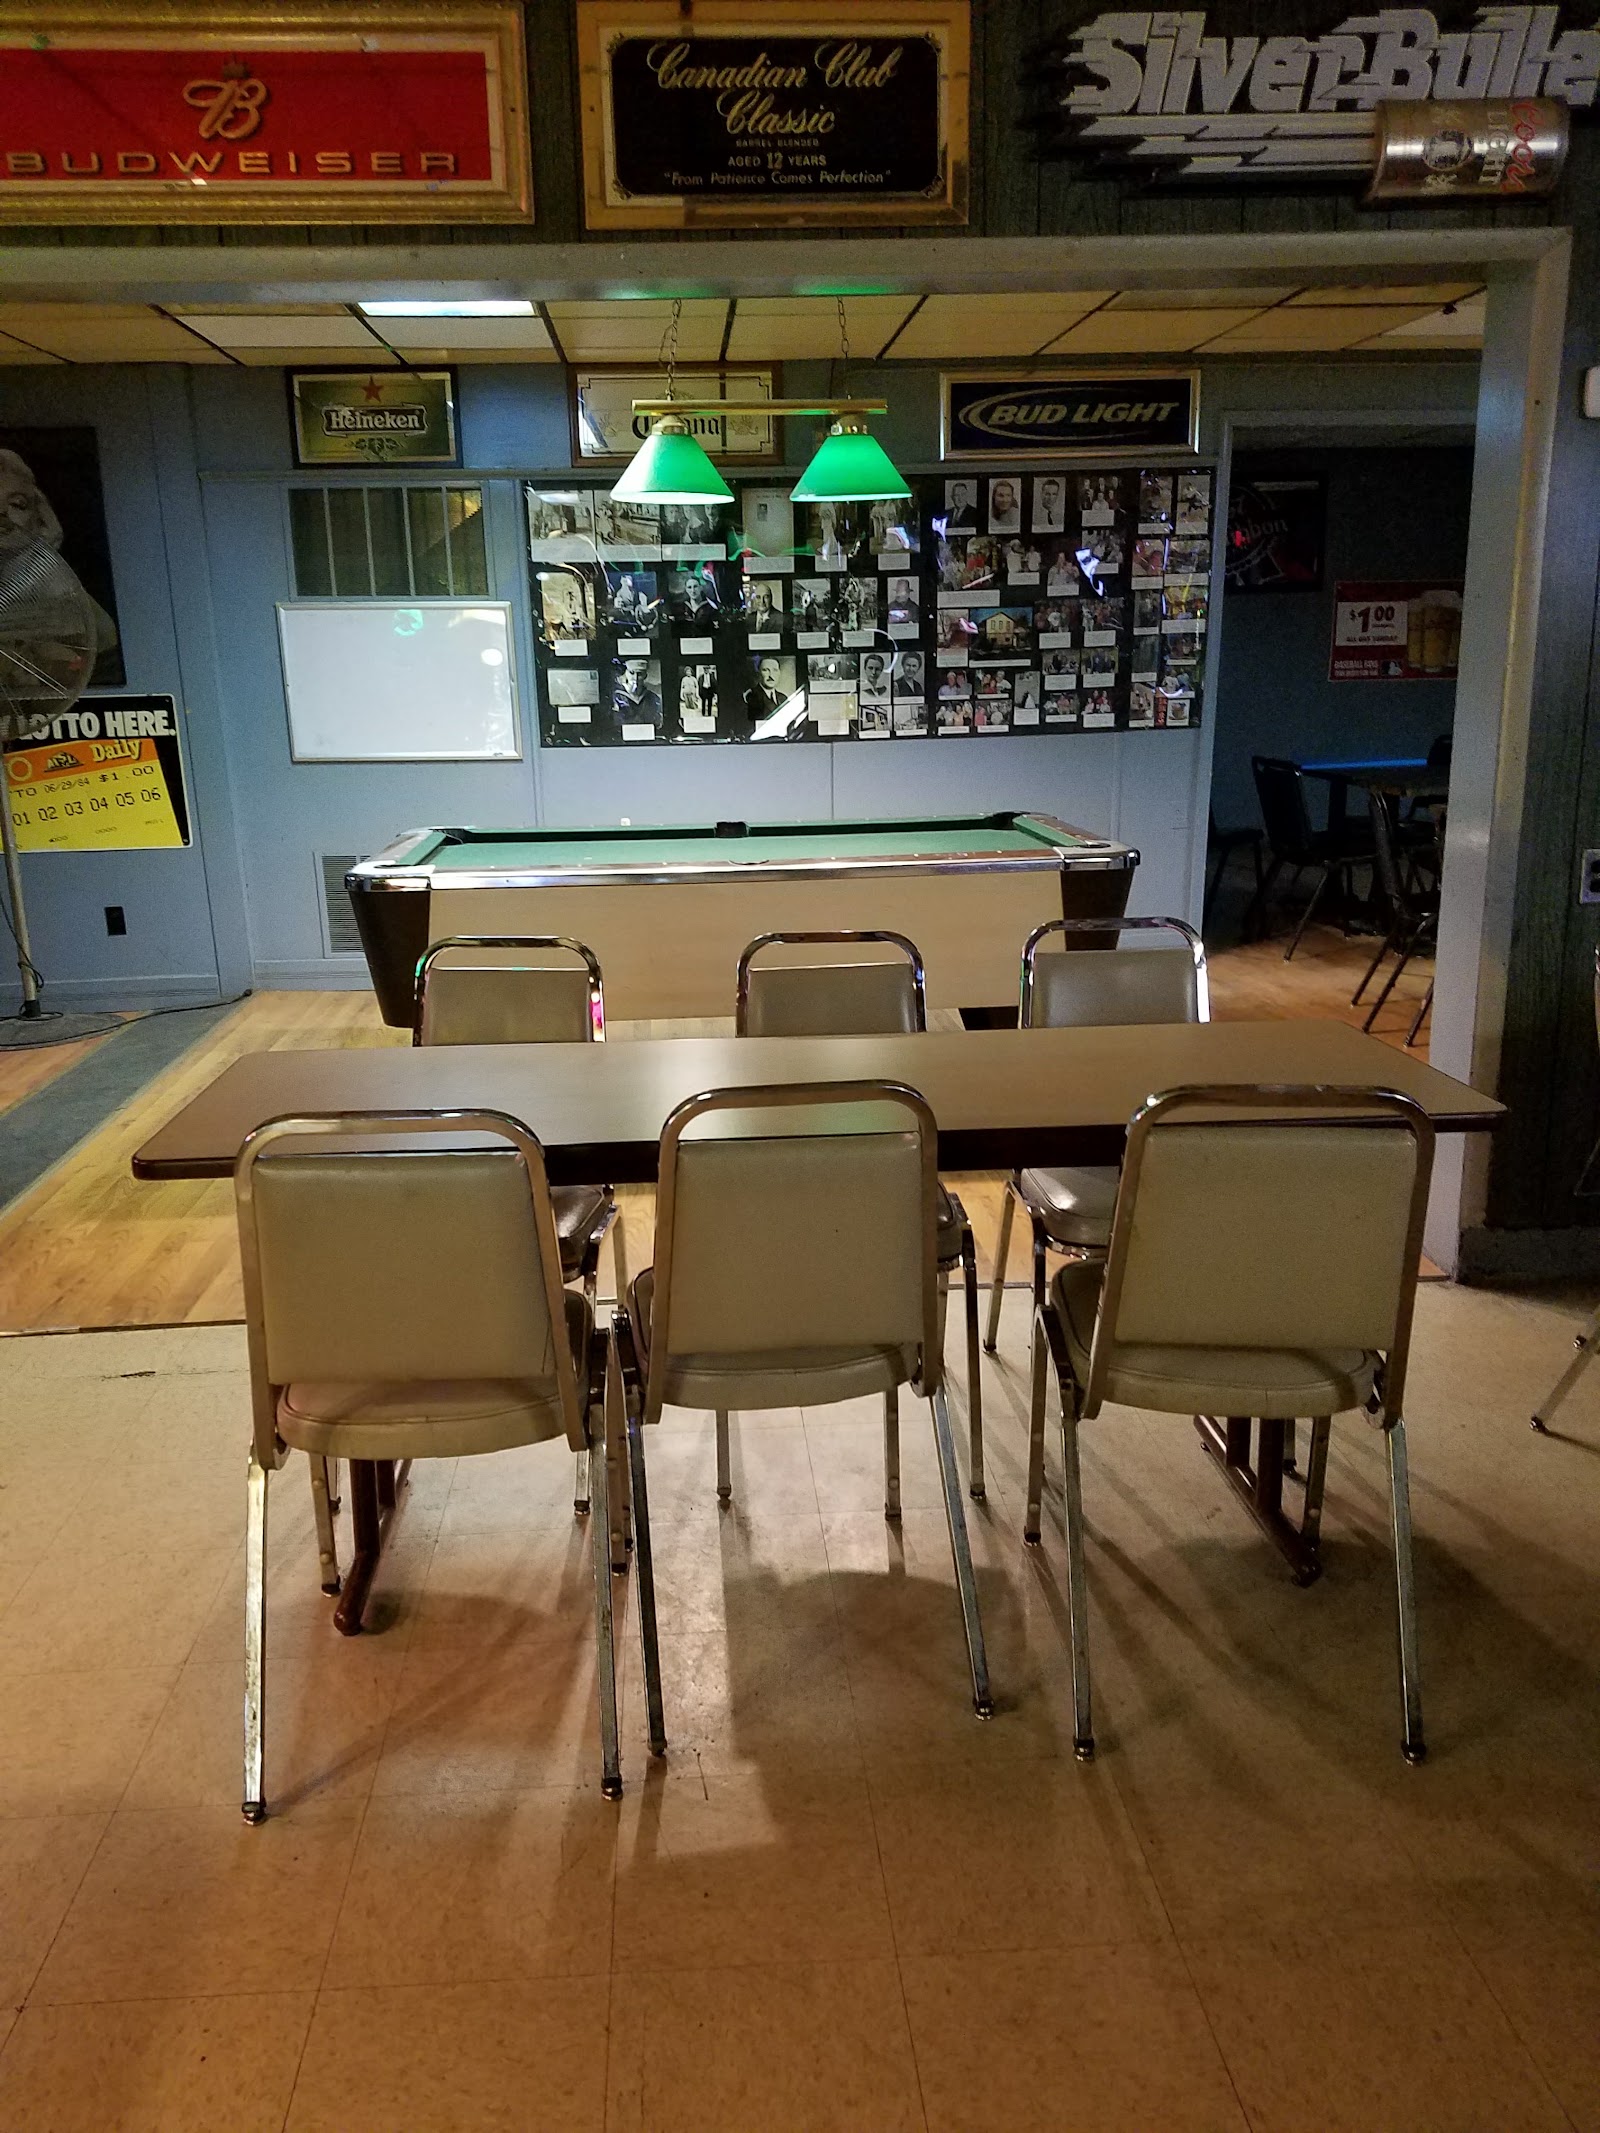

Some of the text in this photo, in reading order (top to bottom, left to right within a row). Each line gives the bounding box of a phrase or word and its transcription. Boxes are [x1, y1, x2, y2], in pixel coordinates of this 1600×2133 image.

[646, 40, 904, 90] Canadian Club
[716, 89, 837, 135] Classic
[5, 150, 458, 174] BUDWEISER
[728, 152, 828, 169] AGED 12 YEARS
[710, 171, 767, 185] Patience
[771, 171, 814, 184] Comes
[329, 409, 421, 430] Heineken
[987, 401, 1180, 426] BUD LIGHT
[104, 710, 177, 738] HERE.
[89, 739, 142, 763] Daily
[12, 787, 162, 827] 01 02 03 04 05 06
